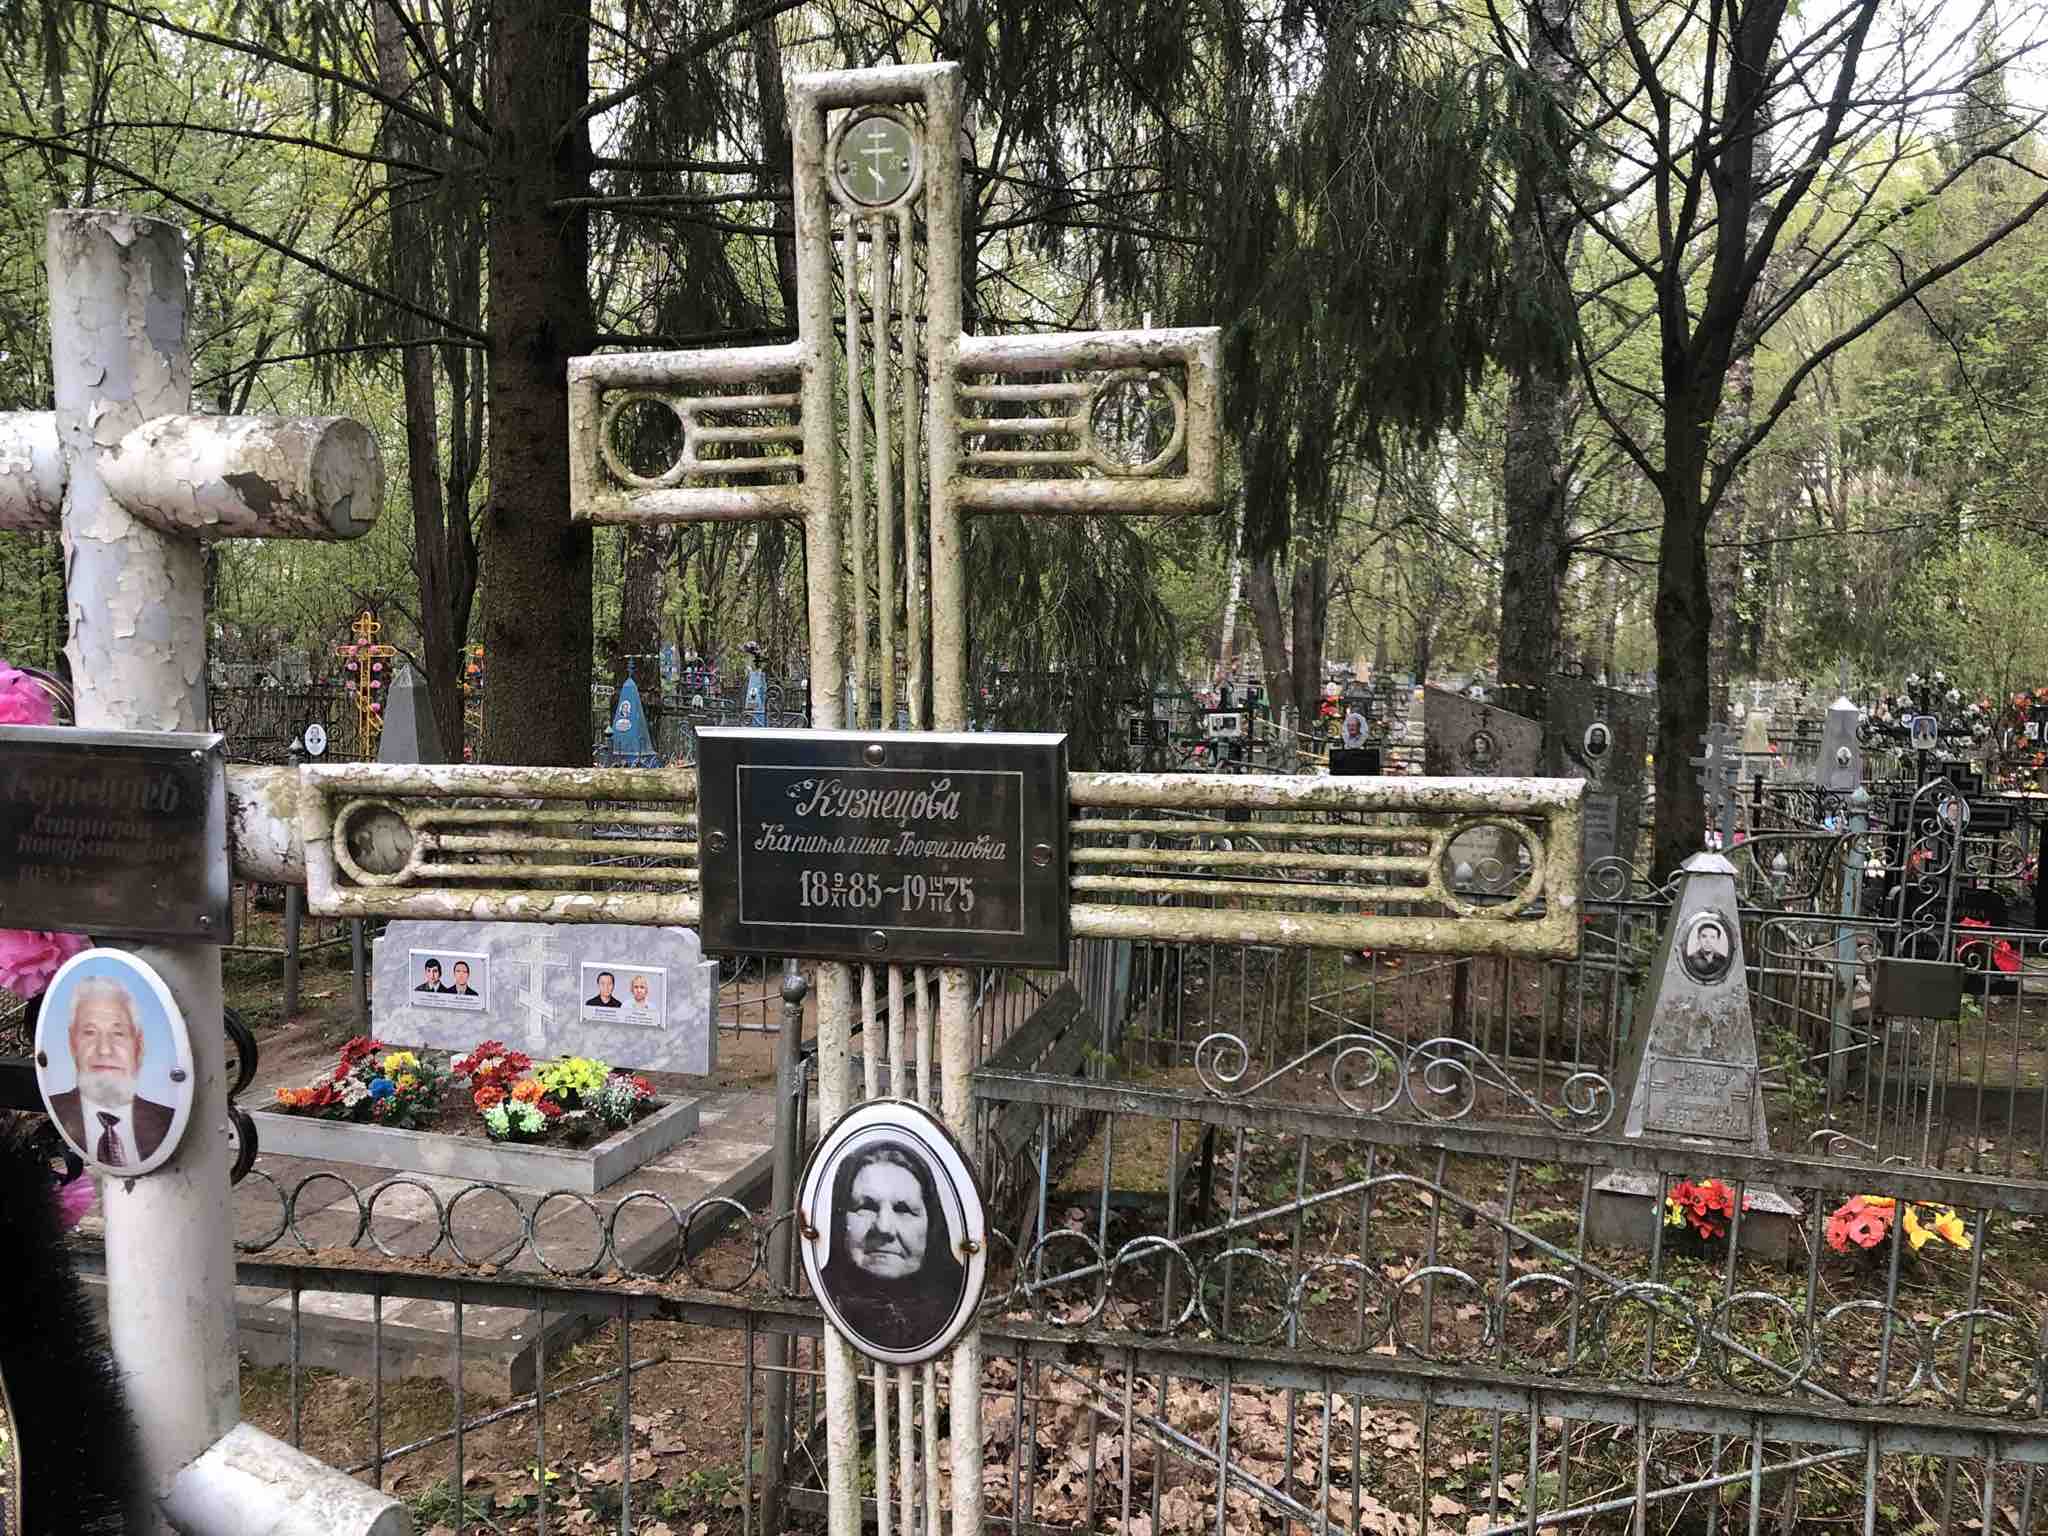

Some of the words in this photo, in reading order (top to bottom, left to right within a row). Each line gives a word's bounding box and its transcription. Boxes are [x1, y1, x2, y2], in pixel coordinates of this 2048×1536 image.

[788, 777, 961, 827] Кузнецова
[754, 822, 890, 856] Капитолина
[894, 831, 1007, 860] Трофимовна
